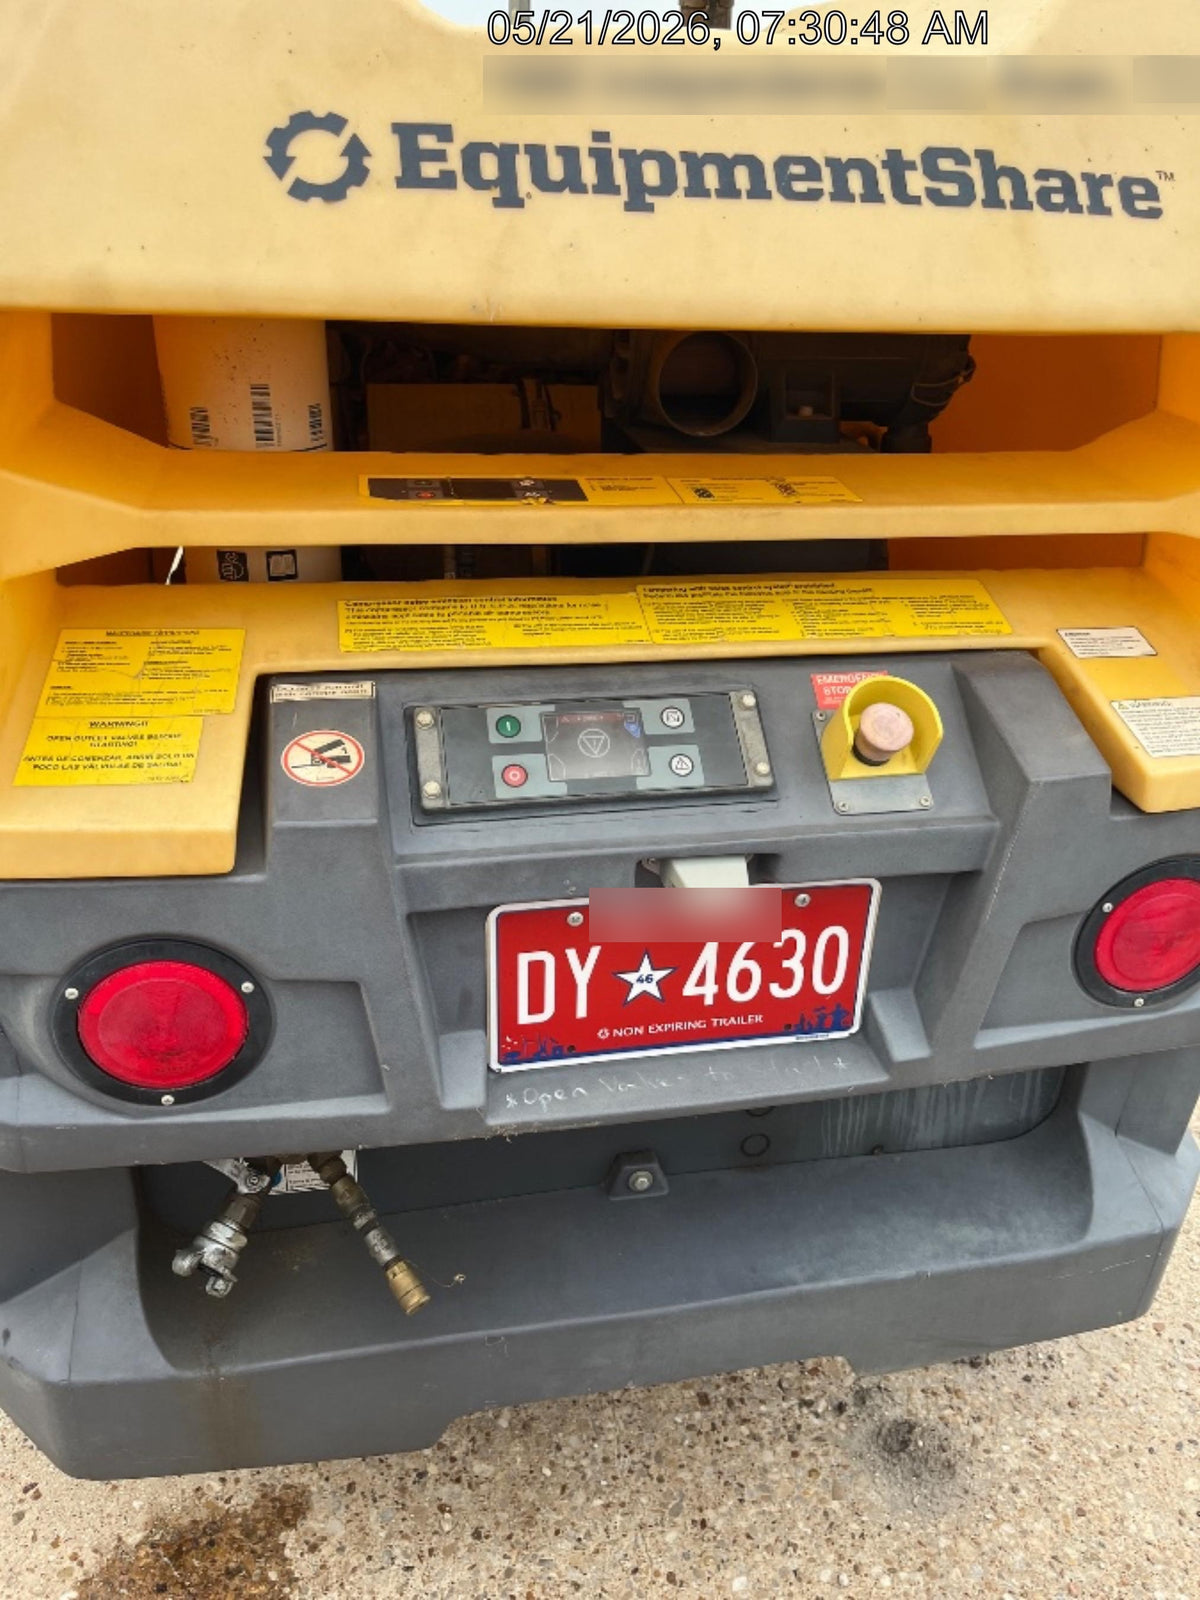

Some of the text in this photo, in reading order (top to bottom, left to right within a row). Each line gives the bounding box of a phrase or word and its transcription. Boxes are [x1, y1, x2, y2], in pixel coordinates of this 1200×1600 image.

[517, 925, 850, 1025] DY 4630
[636, 973, 653, 984] 46
[612, 1014, 764, 1038] NON EXPIRING TRAILER
[521, 1083, 589, 1113] Open
